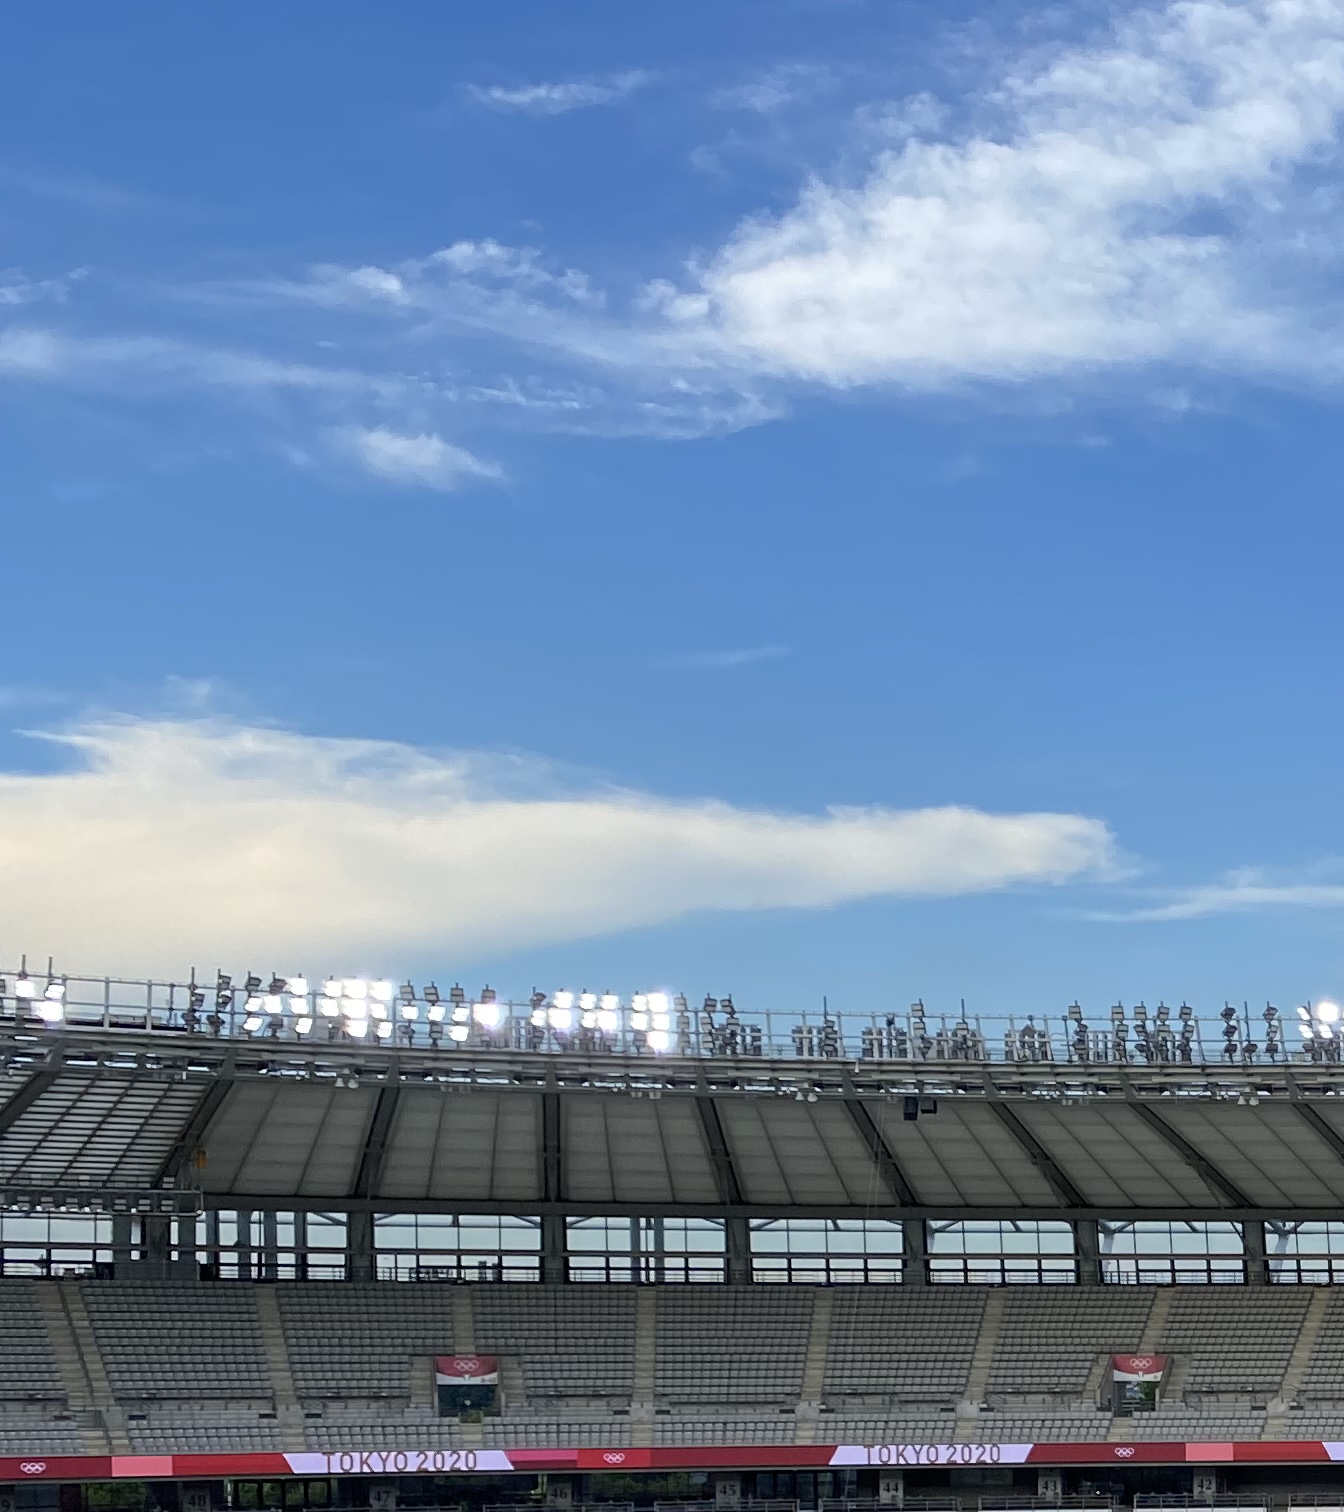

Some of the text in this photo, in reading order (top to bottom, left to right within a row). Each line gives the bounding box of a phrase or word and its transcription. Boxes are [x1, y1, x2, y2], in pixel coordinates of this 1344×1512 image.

[322, 1451, 477, 1473] TOKYO 2020
[863, 1444, 1001, 1464] TOKYO 2020
[883, 1481, 899, 1493] 44
[1197, 1479, 1212, 1490] 42
